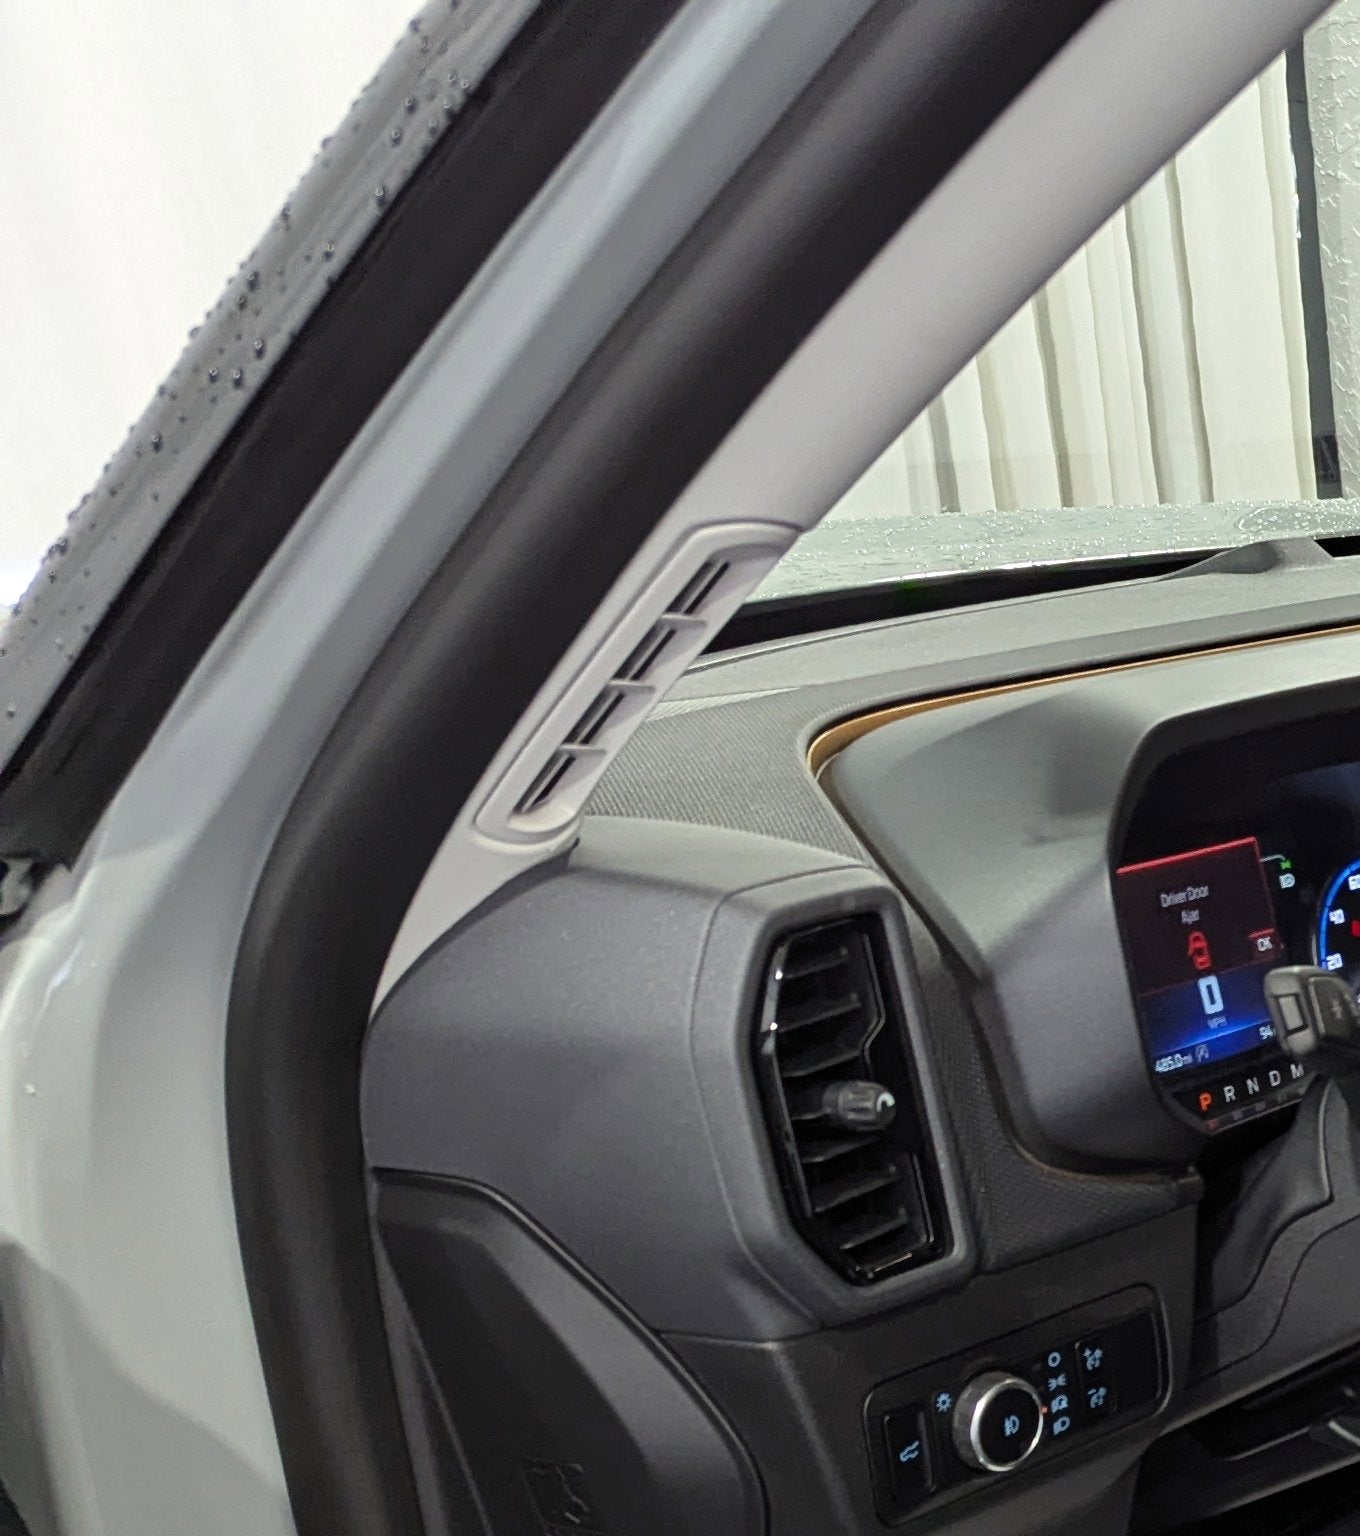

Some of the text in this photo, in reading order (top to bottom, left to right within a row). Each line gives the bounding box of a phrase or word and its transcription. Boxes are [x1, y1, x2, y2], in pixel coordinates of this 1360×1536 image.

[1197, 975, 1224, 1015] 0
[1199, 1091, 1212, 1111] P
[1223, 1085, 1237, 1102] R
[1246, 1077, 1260, 1094] N
[1268, 1070, 1281, 1087] D
